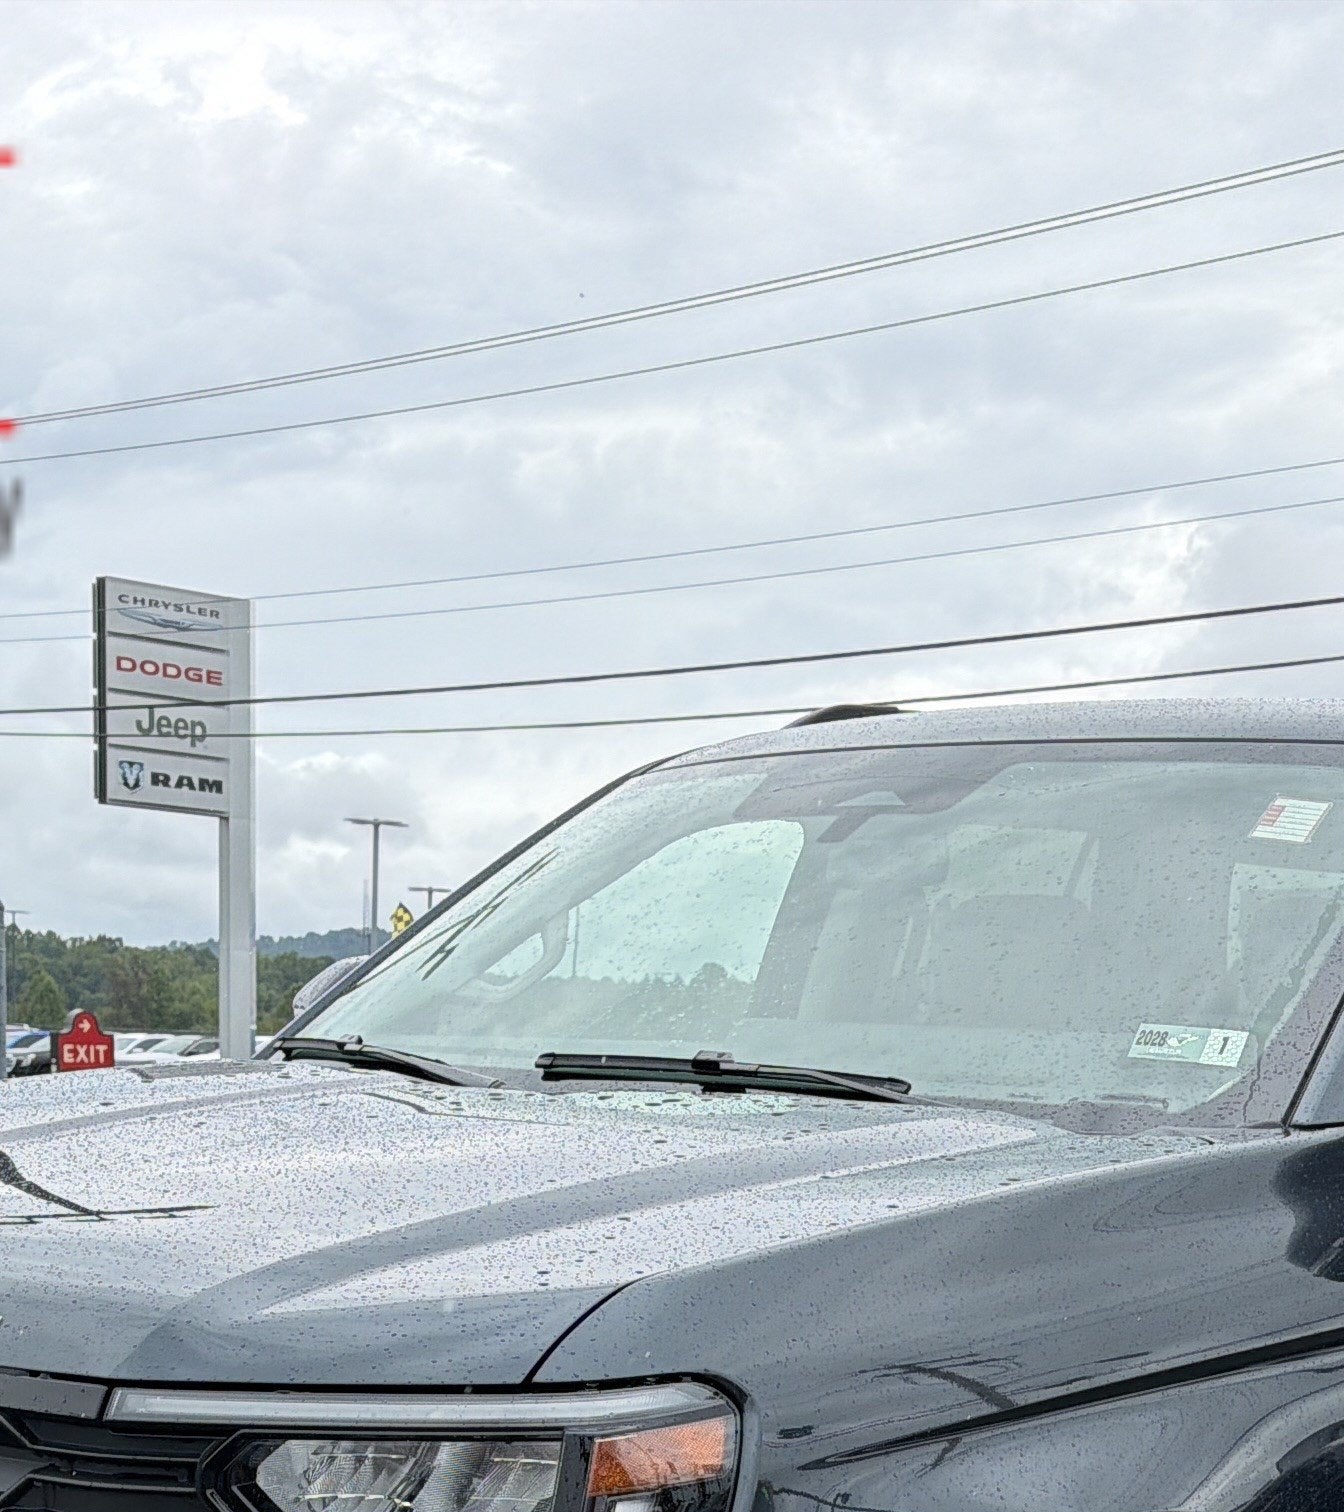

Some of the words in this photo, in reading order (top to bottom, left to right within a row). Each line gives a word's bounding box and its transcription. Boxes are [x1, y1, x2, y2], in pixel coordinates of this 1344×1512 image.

[117, 593, 220, 619] CHRYSLER
[116, 655, 224, 687] DODGE
[135, 706, 208, 748] Jeep
[150, 770, 224, 795] RAM
[1135, 1030, 1169, 1047] 2028
[1218, 1036, 1230, 1056] 1
[63, 1043, 109, 1065] EXIT
